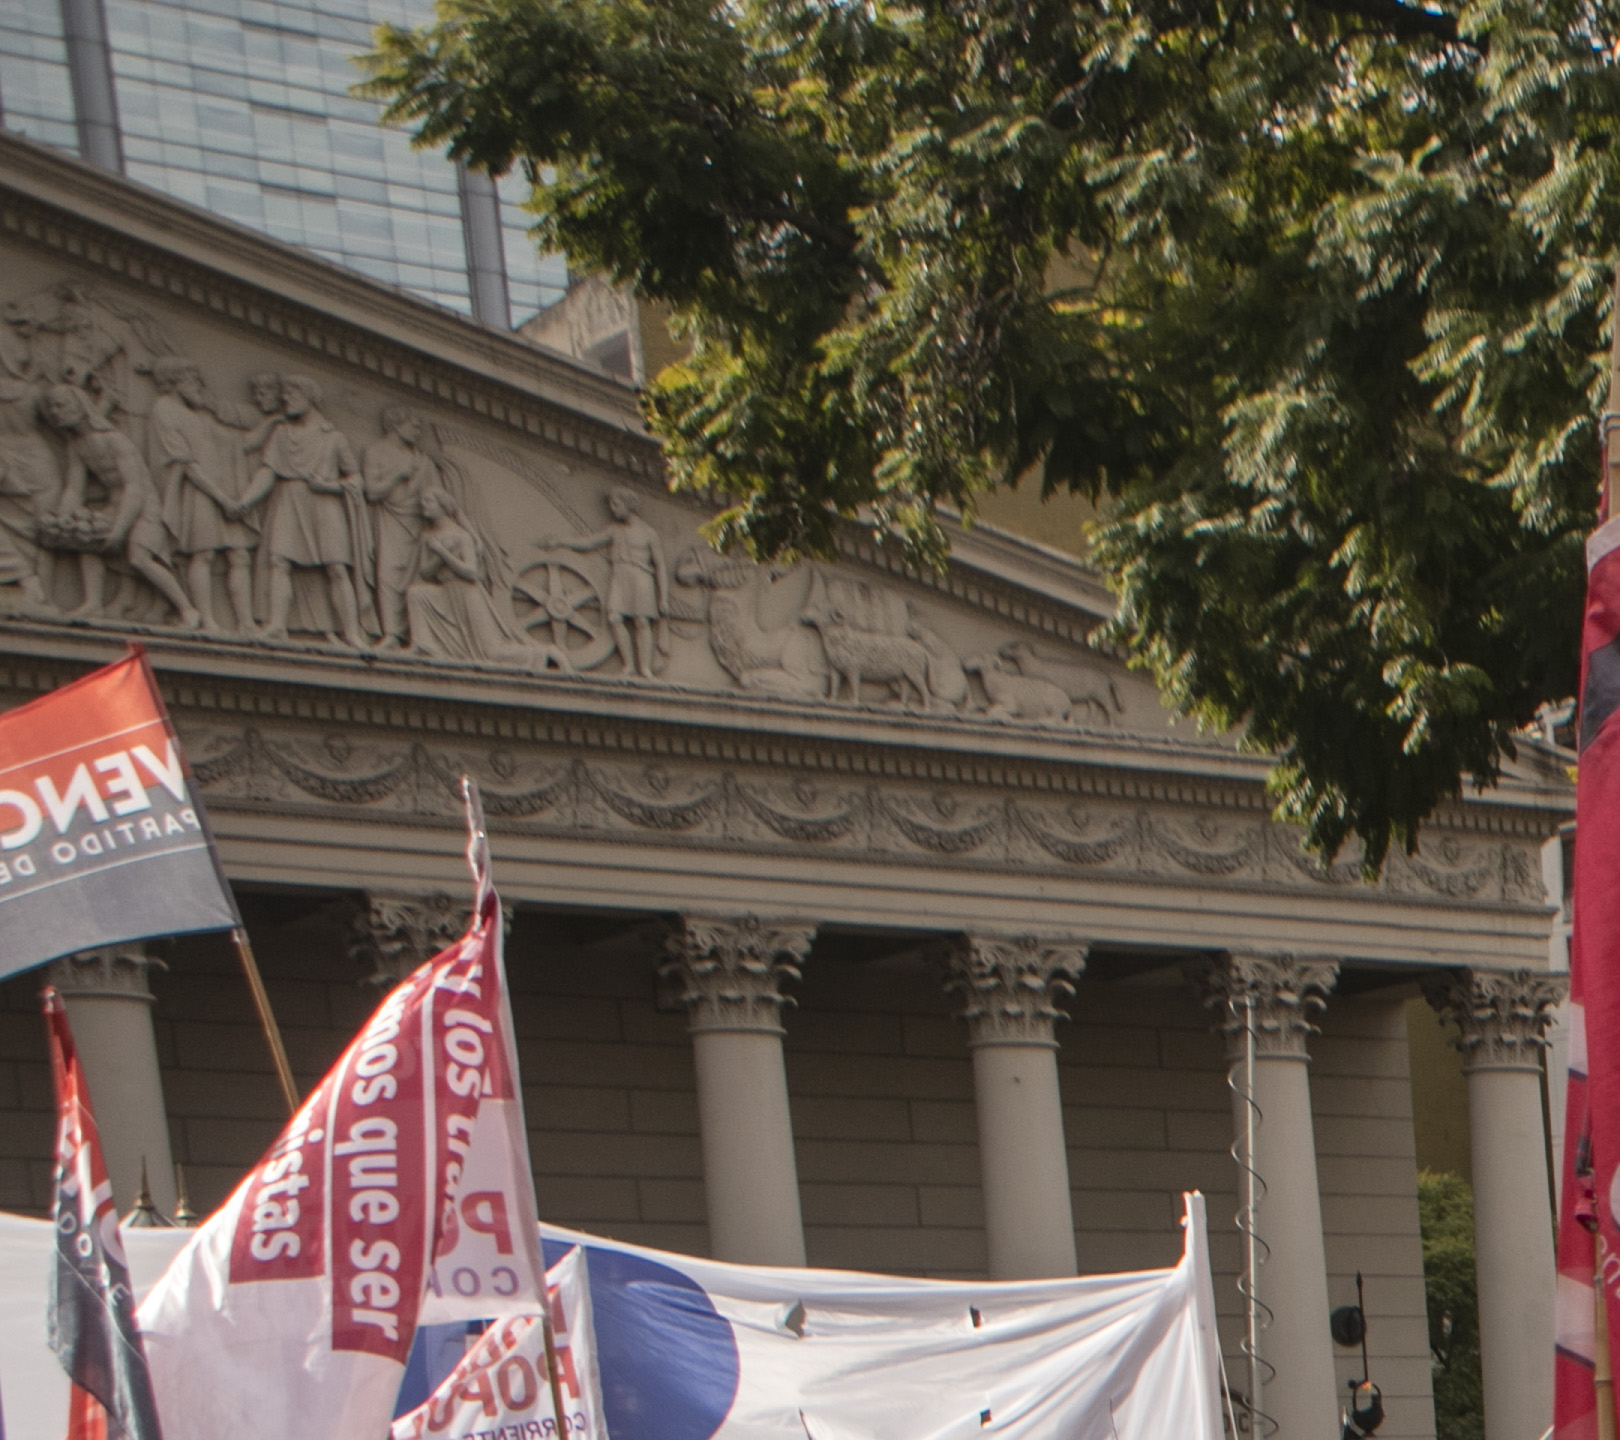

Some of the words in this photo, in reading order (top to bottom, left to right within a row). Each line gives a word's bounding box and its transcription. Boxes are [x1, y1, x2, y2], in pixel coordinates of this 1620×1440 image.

[446, 1008, 495, 1098] los
[332, 1117, 400, 1226] que
[348, 1237, 401, 1342] ser
